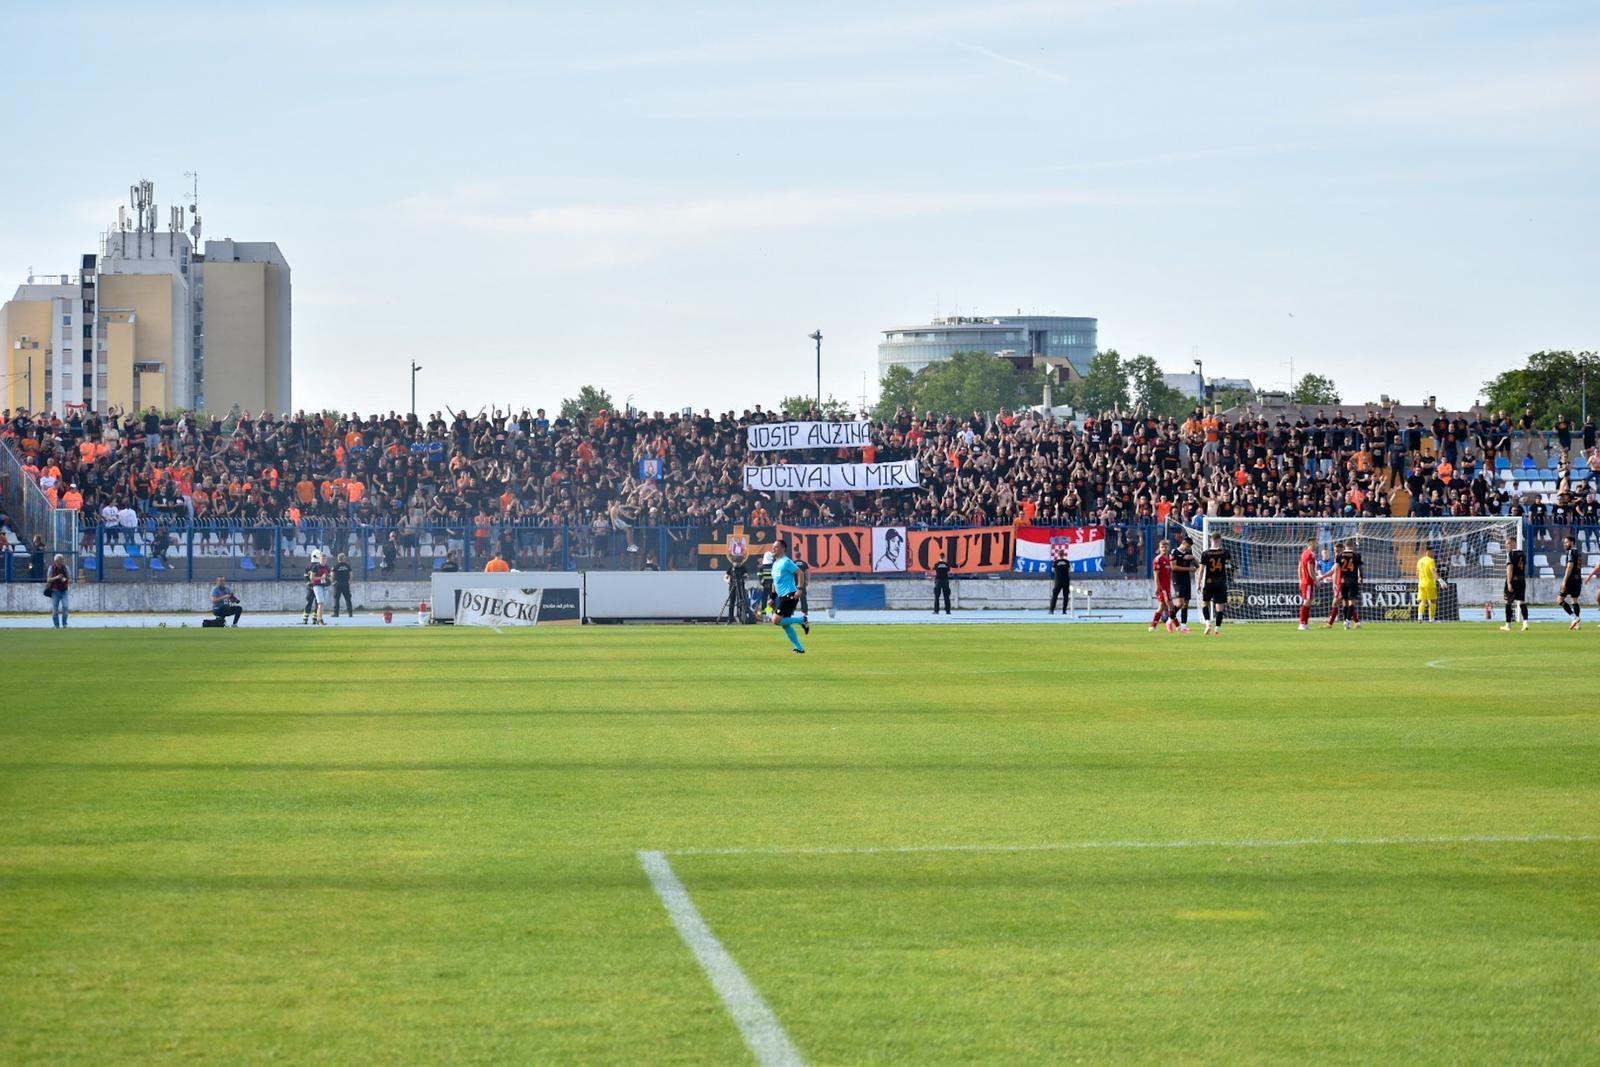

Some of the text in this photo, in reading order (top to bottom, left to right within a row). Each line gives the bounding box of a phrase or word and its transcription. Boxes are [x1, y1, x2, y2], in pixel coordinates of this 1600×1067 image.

[749, 423, 870, 449] JOSIP AUZINA
[841, 466, 856, 487] U
[866, 461, 919, 487] MIRU
[1209, 557, 1222, 572] 34
[1341, 558, 1354, 571] 24
[463, 591, 538, 621] OSJEČKO
[1247, 593, 1303, 608] OSJEČKO
[1362, 592, 1420, 607] RADLE
